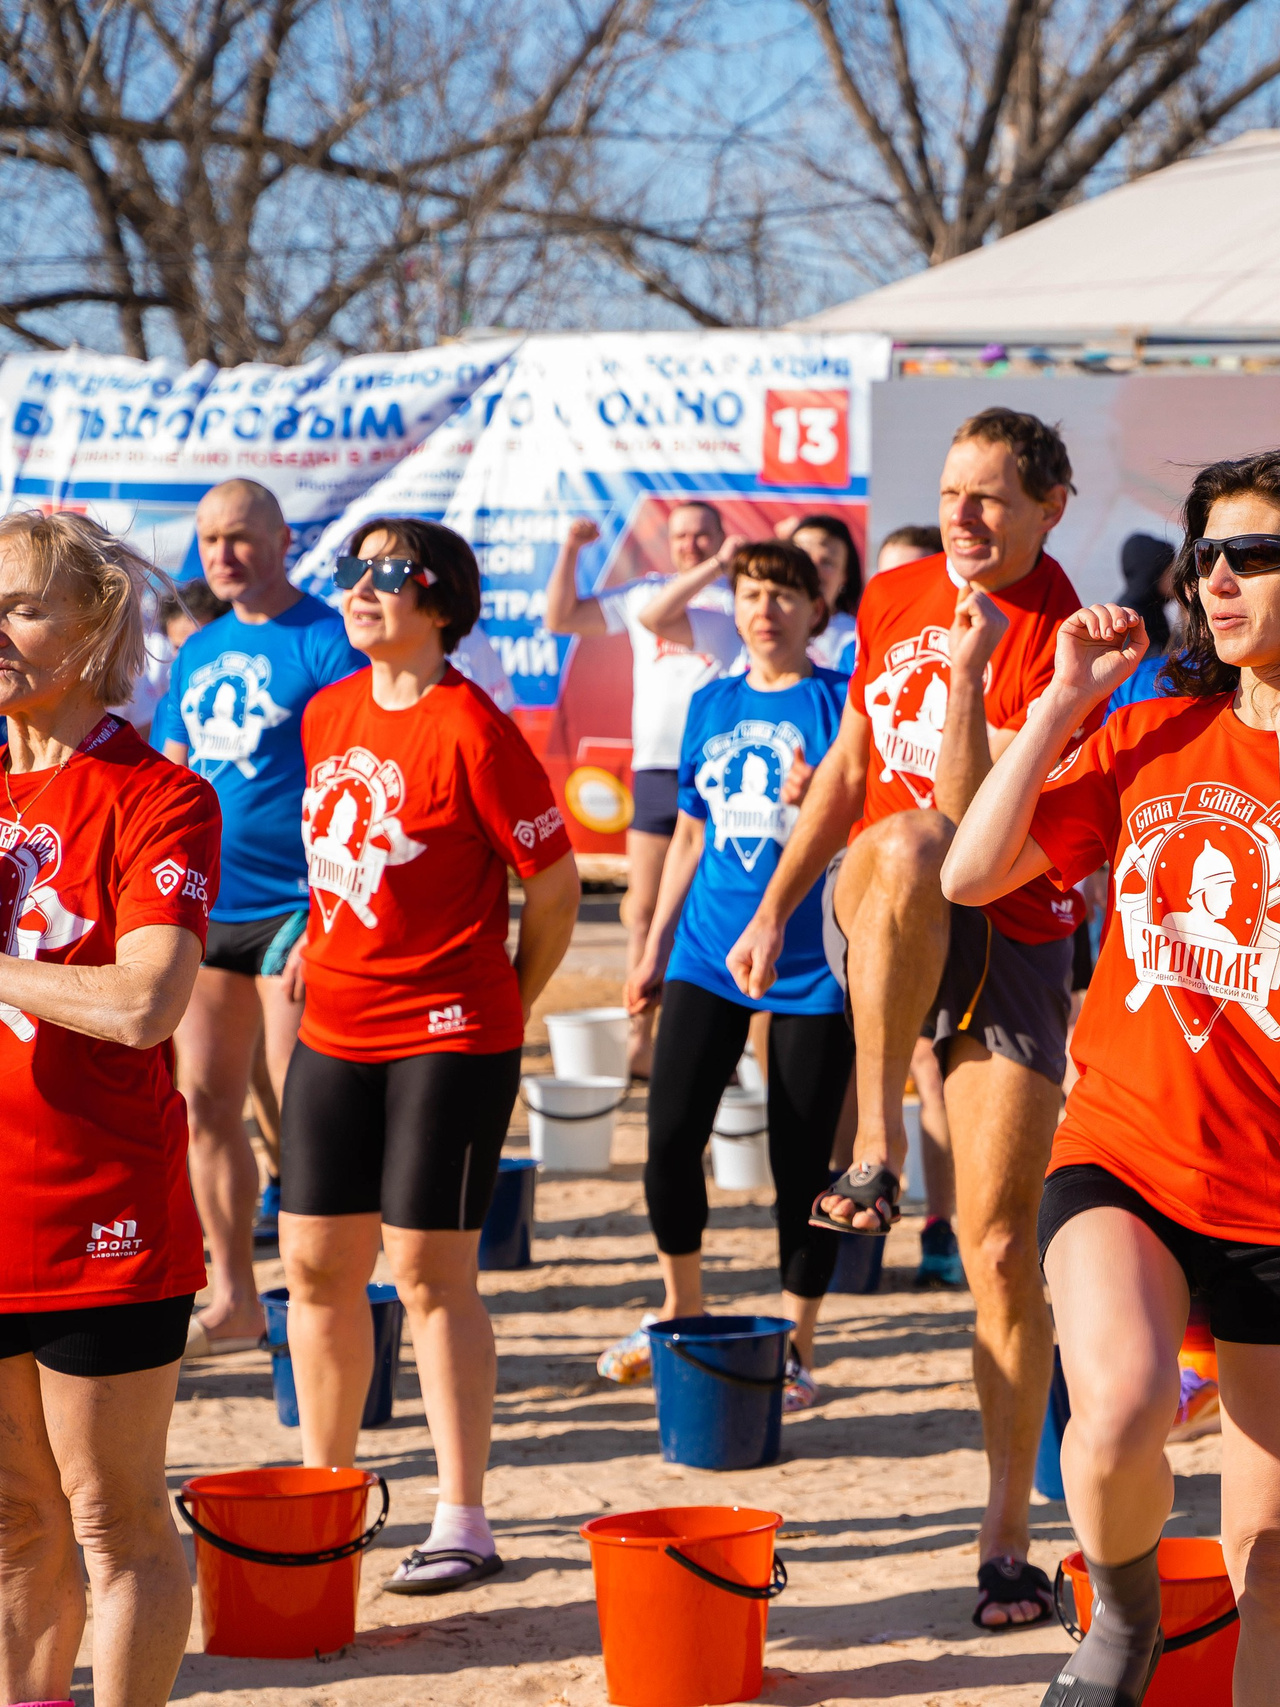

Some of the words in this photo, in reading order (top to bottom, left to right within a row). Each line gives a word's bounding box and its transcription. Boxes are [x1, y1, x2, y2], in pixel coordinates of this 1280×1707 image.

[771, 405, 841, 466] 13
[1135, 801, 1174, 834] СИЛА
[1198, 787, 1258, 824] СЛАВА
[1240, 983, 1260, 1002] КЛУБ
[86, 1239, 143, 1252] SPORT
[91, 1251, 138, 1259] LABORATORY
